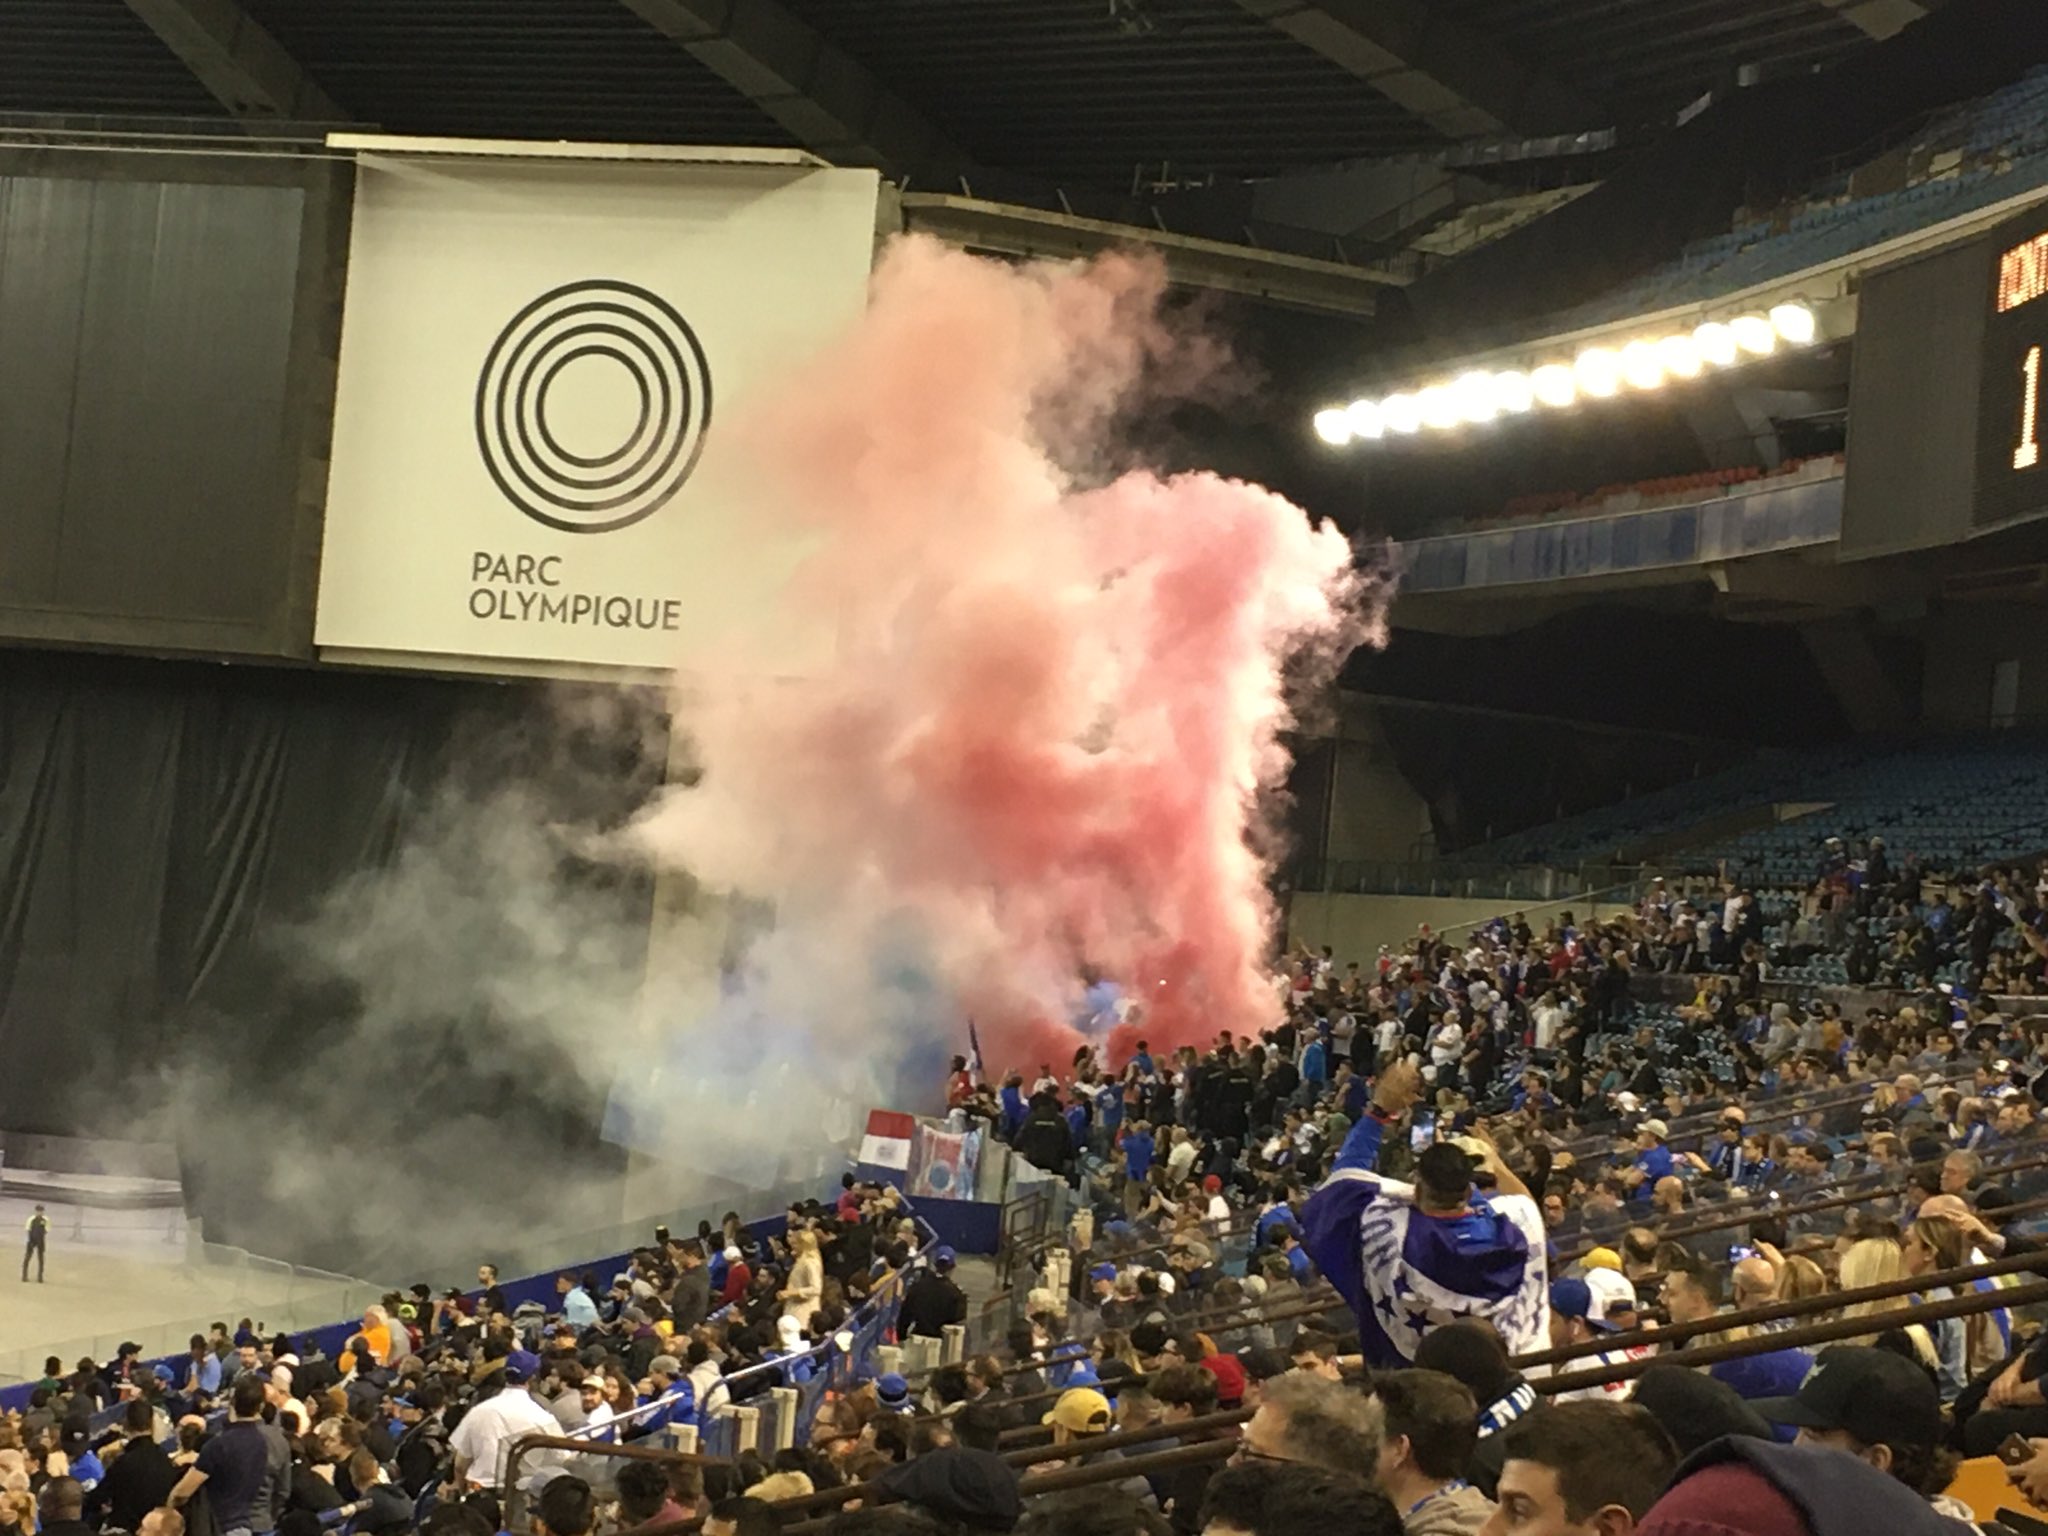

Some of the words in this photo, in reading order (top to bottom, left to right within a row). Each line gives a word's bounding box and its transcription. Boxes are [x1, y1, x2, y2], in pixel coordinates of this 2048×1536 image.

[2013, 346, 2040, 469] 1
[472, 551, 562, 586] PARC
[469, 588, 682, 631] OLYMPIQUE
